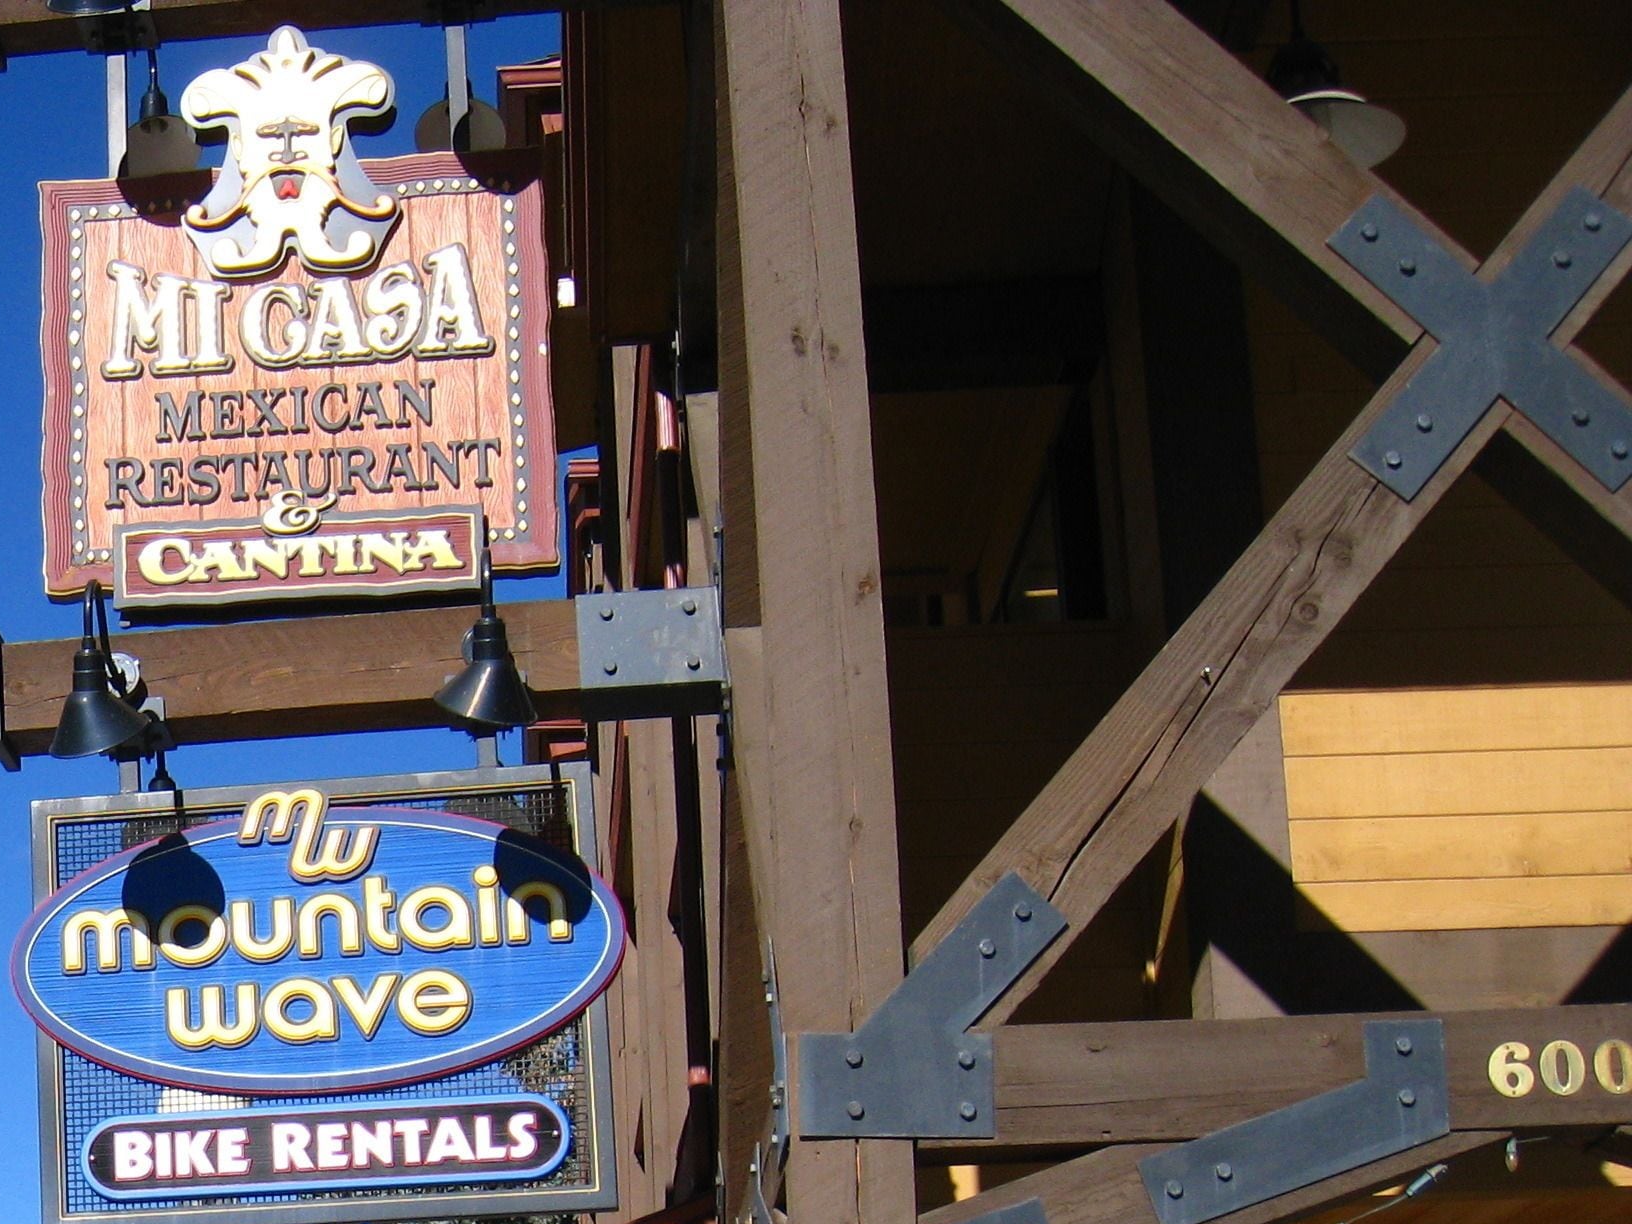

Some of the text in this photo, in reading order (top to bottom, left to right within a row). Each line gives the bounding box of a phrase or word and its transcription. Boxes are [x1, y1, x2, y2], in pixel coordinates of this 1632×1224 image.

[102, 242, 496, 378] MI CASA
[154, 379, 437, 443] MEXICAN
[103, 437, 502, 509] RESTAURANT
[261, 488, 337, 536] &
[136, 528, 465, 587] CANTINA
[61, 864, 577, 975] mountain
[164, 968, 473, 1051] wave
[112, 1112, 542, 1183] BIKE RENTALS
